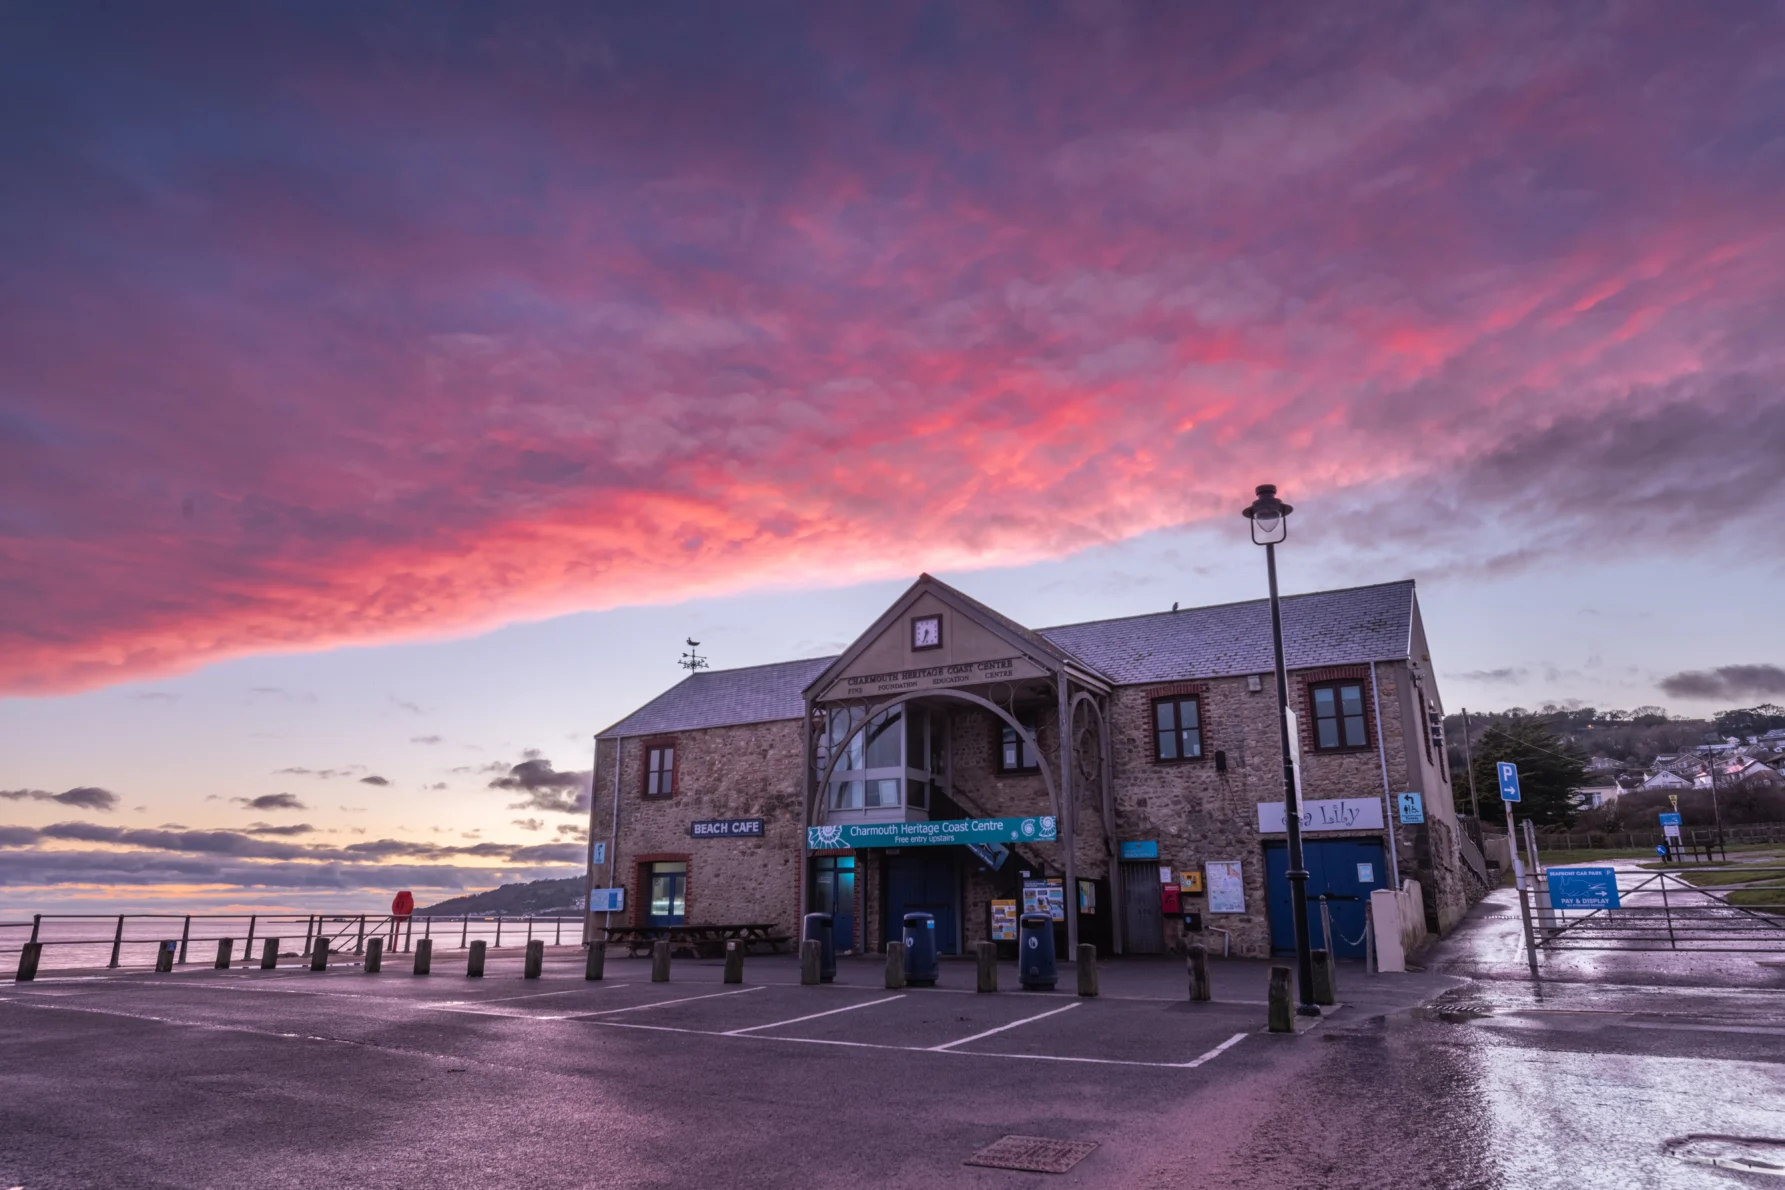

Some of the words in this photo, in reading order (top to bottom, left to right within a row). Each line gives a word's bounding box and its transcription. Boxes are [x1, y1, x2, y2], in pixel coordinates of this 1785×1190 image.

[847, 675, 899, 686] CHARMOUTH
[902, 668, 943, 680] HERITAGE
[947, 664, 973, 675] COAST
[977, 660, 1013, 671] CENTRE
[878, 681, 918, 691] FOUNDATION
[932, 675, 969, 685] EDUCATION
[984, 670, 1013, 679] CENTRE
[1503, 765, 1512, 781] P
[1319, 801, 1360, 827] Lily
[694, 823, 728, 834] BEACH
[732, 821, 759, 832] CAFE
[850, 824, 898, 837] Charmouth
[901, 823, 940, 836] Heritage
[942, 821, 969, 832] Coast
[971, 820, 1004, 831] Centre
[910, 836, 927, 844] entry
[929, 835, 955, 843] upstairs
